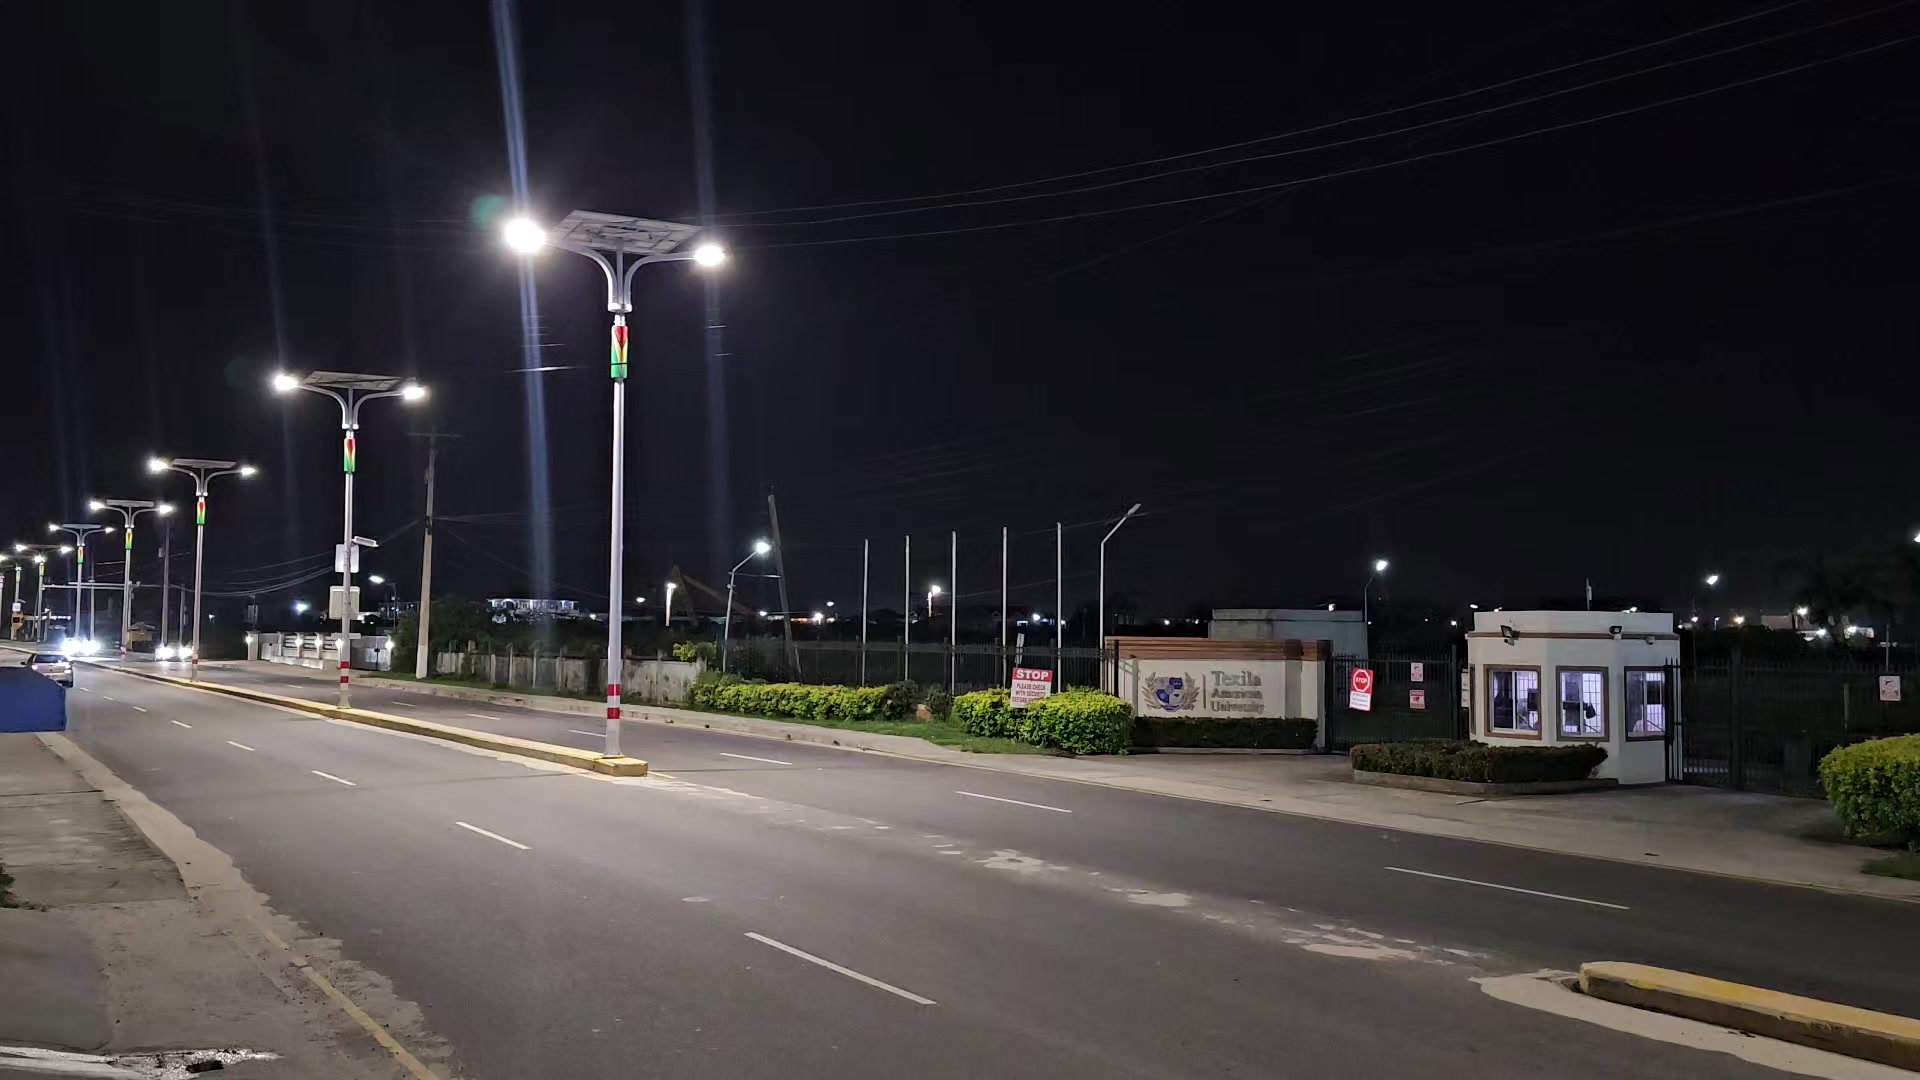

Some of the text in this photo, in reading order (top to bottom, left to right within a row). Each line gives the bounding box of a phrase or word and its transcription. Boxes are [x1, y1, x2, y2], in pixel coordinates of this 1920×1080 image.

[1016, 669, 1048, 680] STOP
[1211, 671, 1261, 686] Texila
[1211, 688, 1262, 698] American
[1210, 701, 1264, 714] University
